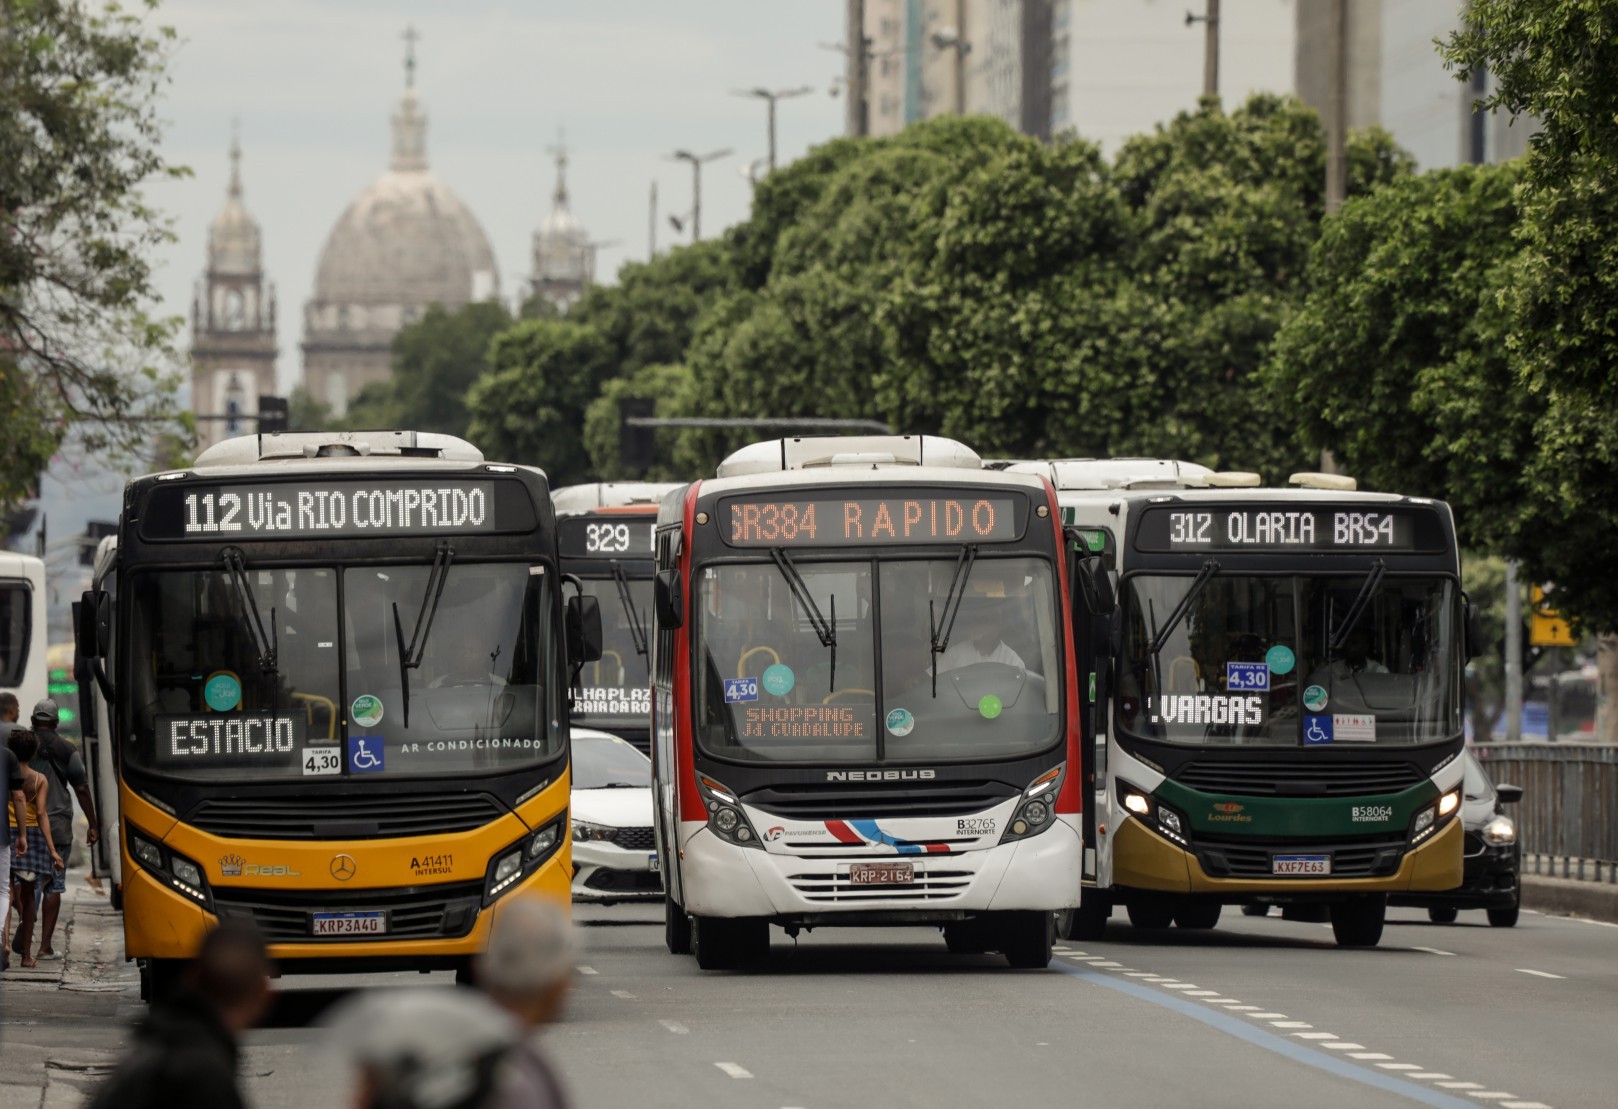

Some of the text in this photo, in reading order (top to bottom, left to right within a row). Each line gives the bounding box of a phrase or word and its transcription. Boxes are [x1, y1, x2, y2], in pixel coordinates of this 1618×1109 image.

[186, 488, 485, 532] 112 Via RIO COMPRIDO
[844, 500, 994, 538] RAPIDO
[1170, 512, 1394, 544] 312 OLARIA BRS4
[586, 523, 629, 552] 329
[1230, 671, 1266, 688] 4,30
[727, 683, 757, 700] 4,30
[746, 708, 853, 722] SHOPPING
[171, 718, 293, 755] ESTACIO
[771, 723, 863, 737] GUADALUPE
[401, 738, 541, 753] AR CONDICIONADO
[305, 755, 339, 772] 4,30
[827, 769, 936, 781] NEOBUS
[1208, 812, 1252, 821] Lourdes
[1352, 806, 1392, 817] B58064
[957, 818, 996, 830] B32765
[415, 866, 452, 876] INTERSUL
[1277, 861, 1324, 873] KXF7E63
[319, 918, 377, 933] KRP3A40
